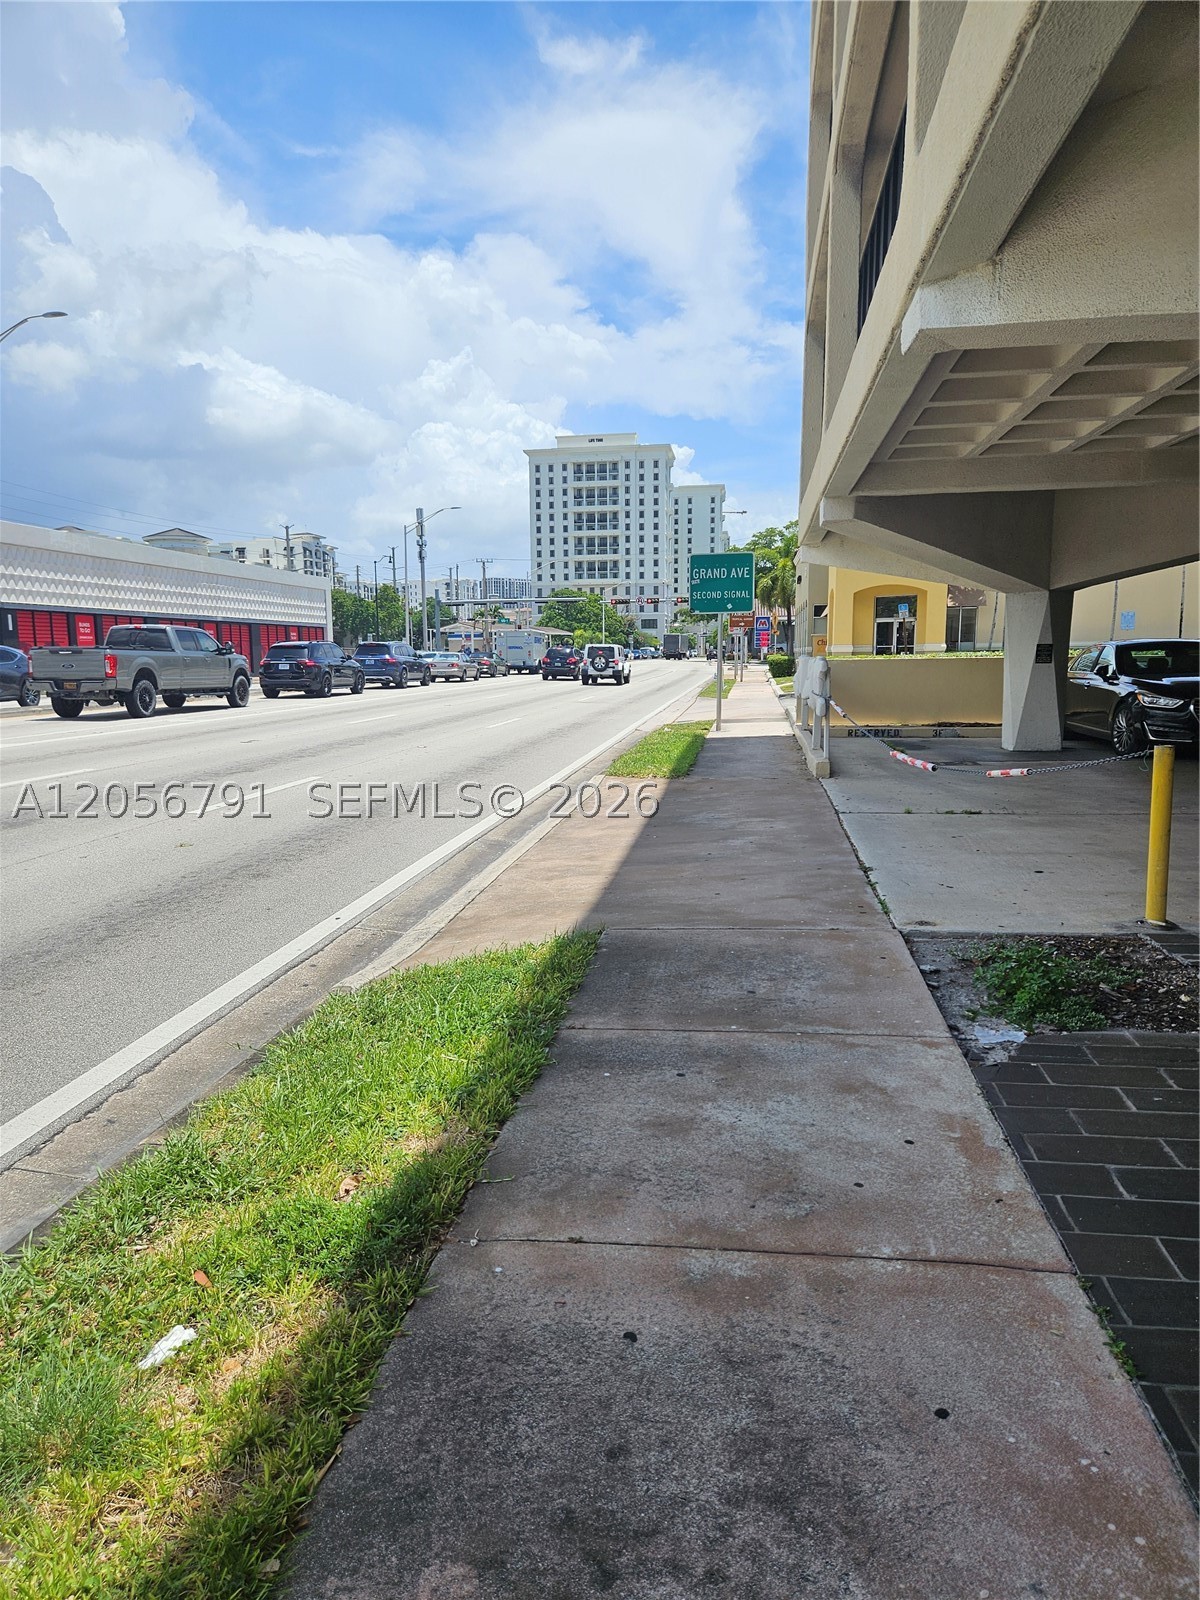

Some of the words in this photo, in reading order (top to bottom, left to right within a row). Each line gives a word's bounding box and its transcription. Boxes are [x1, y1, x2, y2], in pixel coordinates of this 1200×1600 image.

[692, 567, 727, 579] GRAND
[730, 567, 750, 578] AVE
[692, 590, 722, 599] SECOND
[723, 590, 750, 599] SIGNAL
[847, 729, 900, 737] RESERVED
